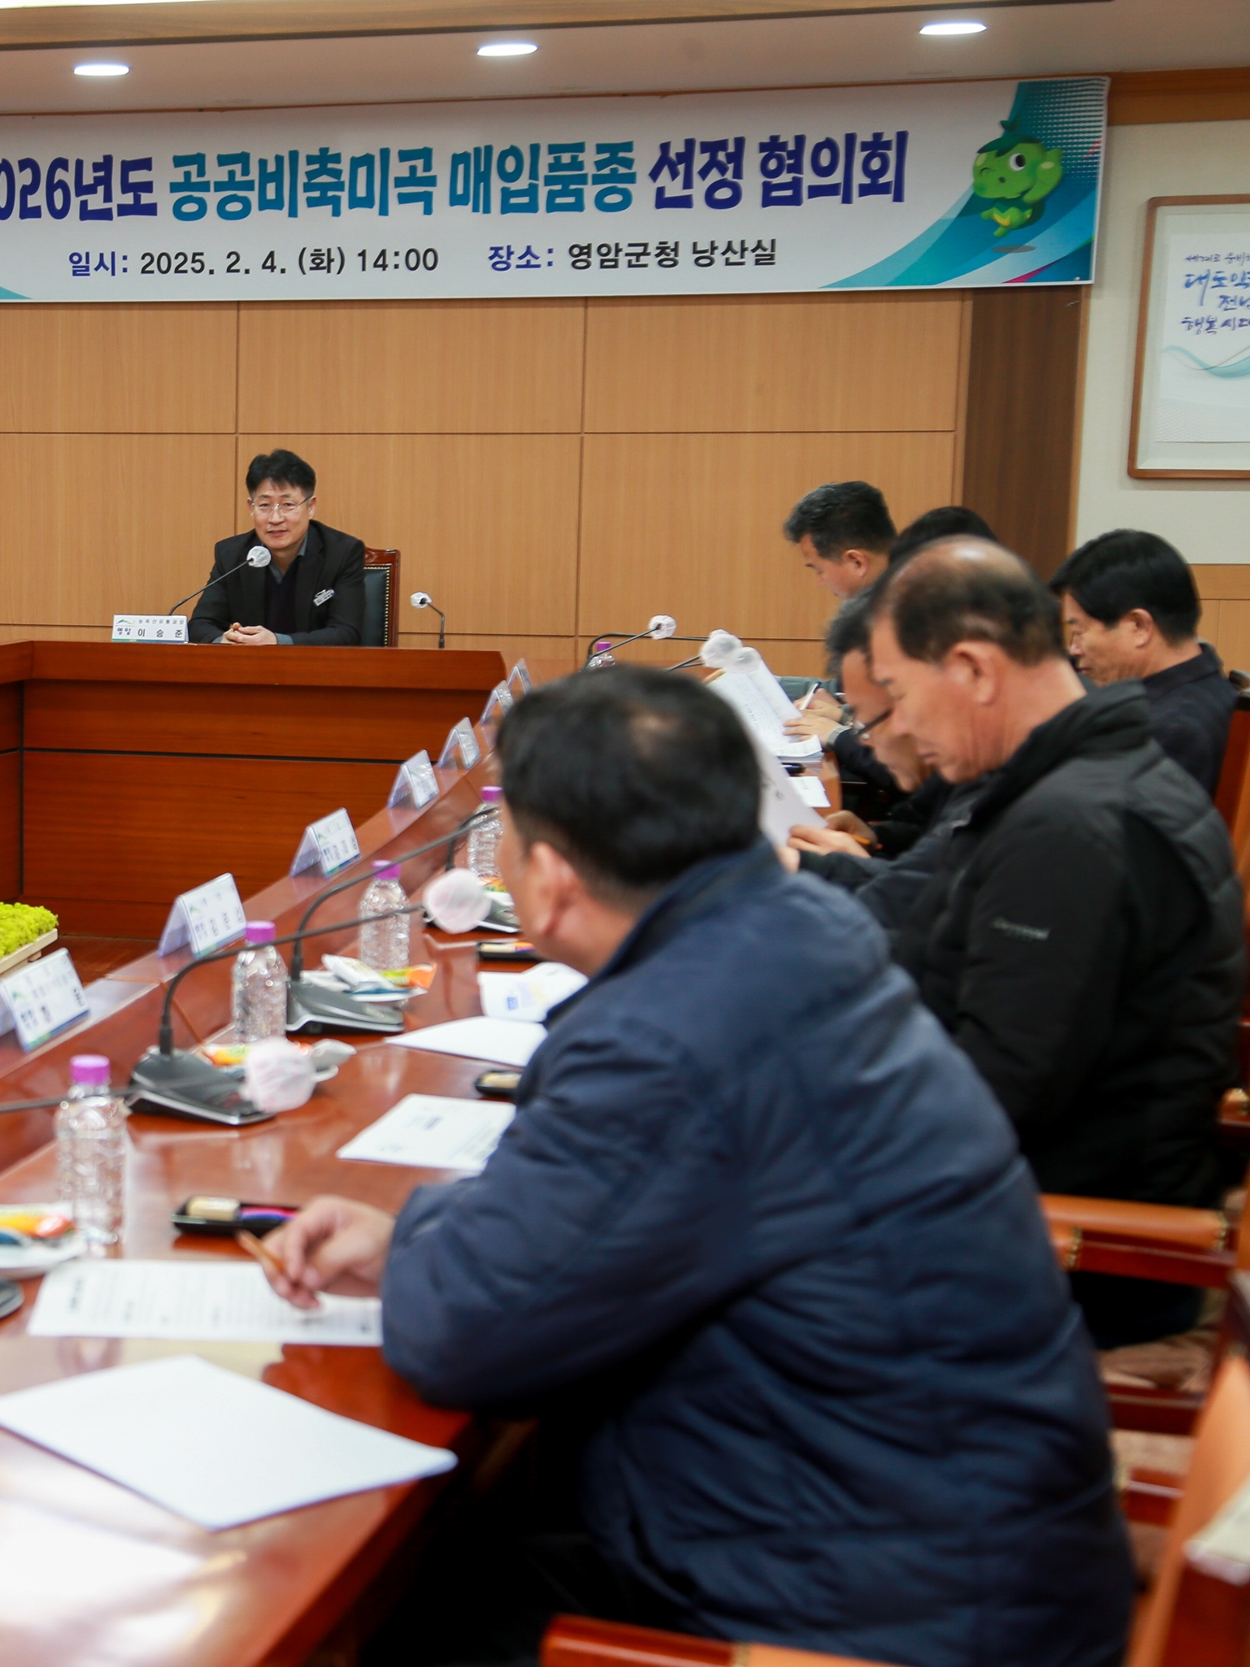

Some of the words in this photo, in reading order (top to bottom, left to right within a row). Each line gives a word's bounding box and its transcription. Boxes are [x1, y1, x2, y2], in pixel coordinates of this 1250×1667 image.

[168, 146, 438, 221] 공공비축미곡
[449, 140, 637, 215] 매입품종
[648, 135, 746, 210] 선정
[758, 130, 910, 209] 협의회
[68, 250, 129, 276] 일시:
[140, 251, 215, 276] 2025.
[297, 246, 347, 275] (화)
[356, 247, 440, 273] 14:00
[488, 244, 554, 271] 장소:
[567, 241, 681, 270] 영암군청
[691, 238, 778, 267] 낭산실
